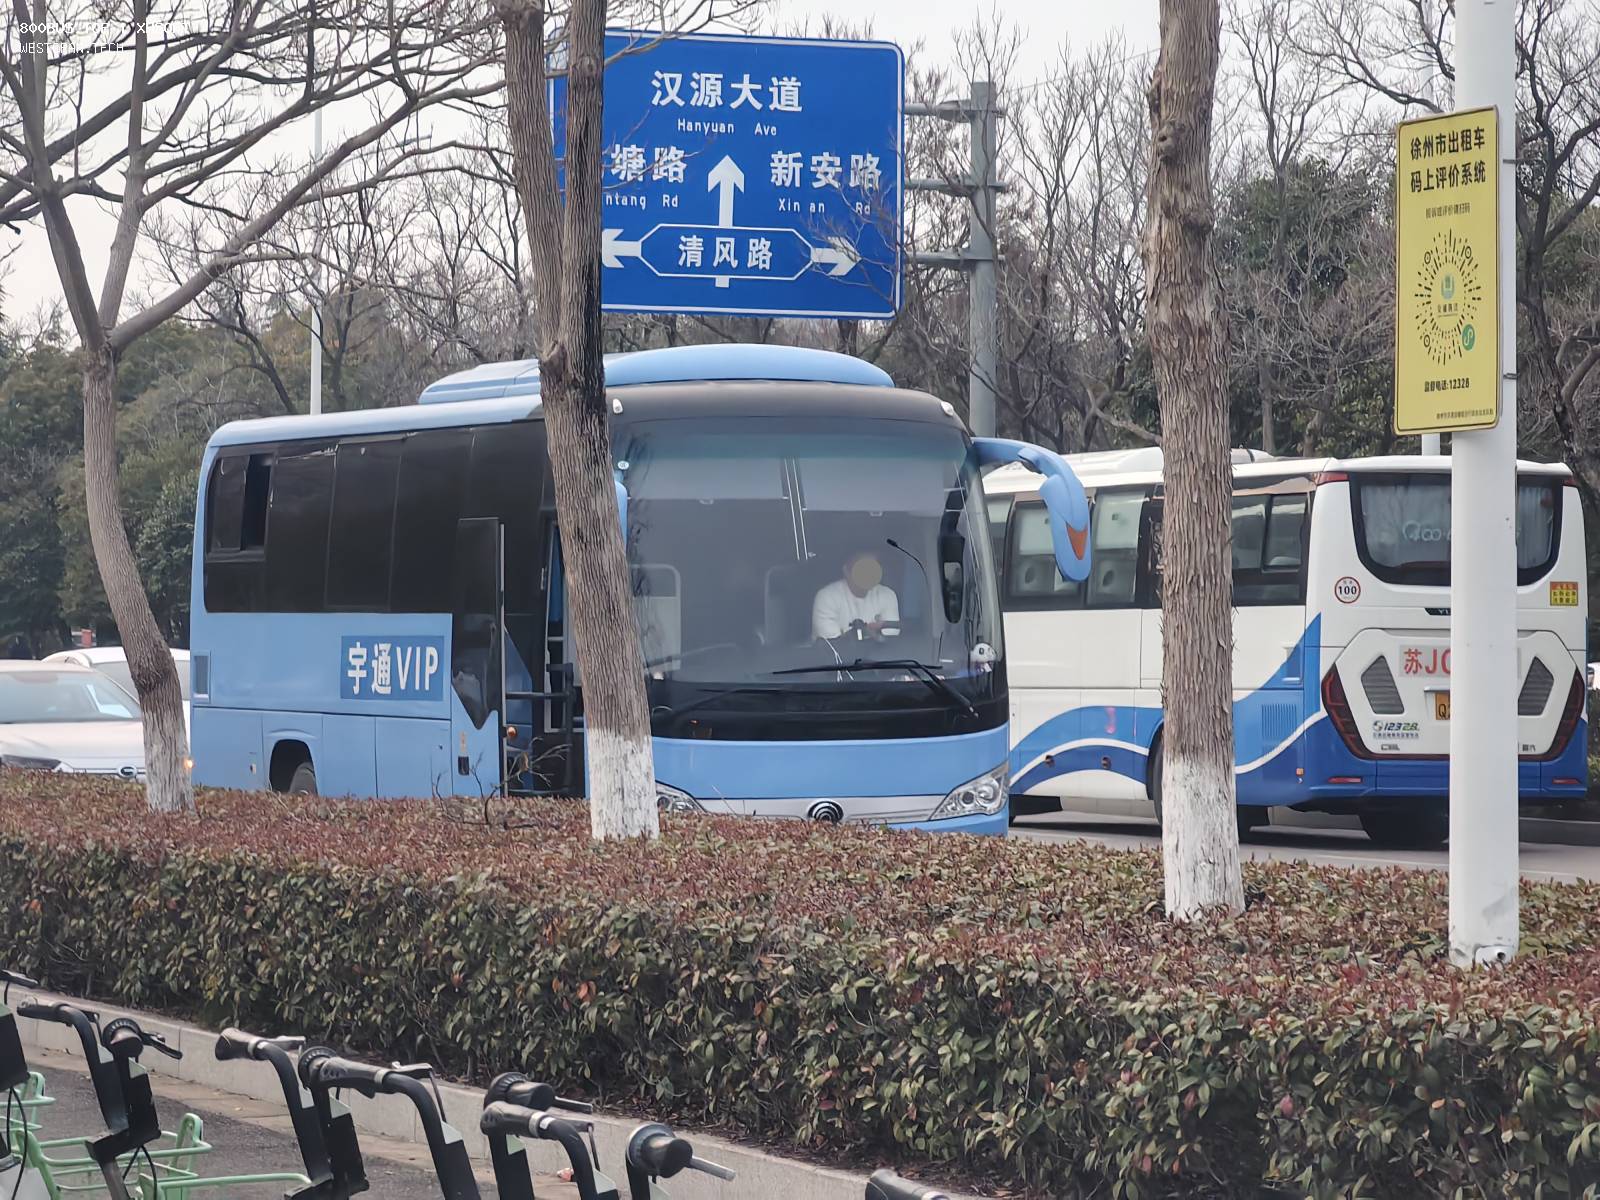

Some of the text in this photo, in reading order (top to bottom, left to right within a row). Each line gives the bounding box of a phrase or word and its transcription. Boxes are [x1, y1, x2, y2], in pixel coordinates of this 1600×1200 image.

[651, 70, 803, 112] 汉源大道
[677, 118, 777, 137] Hanyuan Ave
[1410, 126, 1486, 160] 徐州市出租车
[602, 144, 687, 183] 塘路
[770, 150, 882, 193] 新安路
[1411, 160, 1486, 193] 码上评价系统
[605, 192, 678, 210] ntang Rd
[778, 198, 871, 215] Xin an Rd
[678, 235, 773, 270] 清风路
[1338, 585, 1357, 595] 100
[347, 641, 439, 695] 宇通VIP
[1384, 722, 1418, 731] 12328
